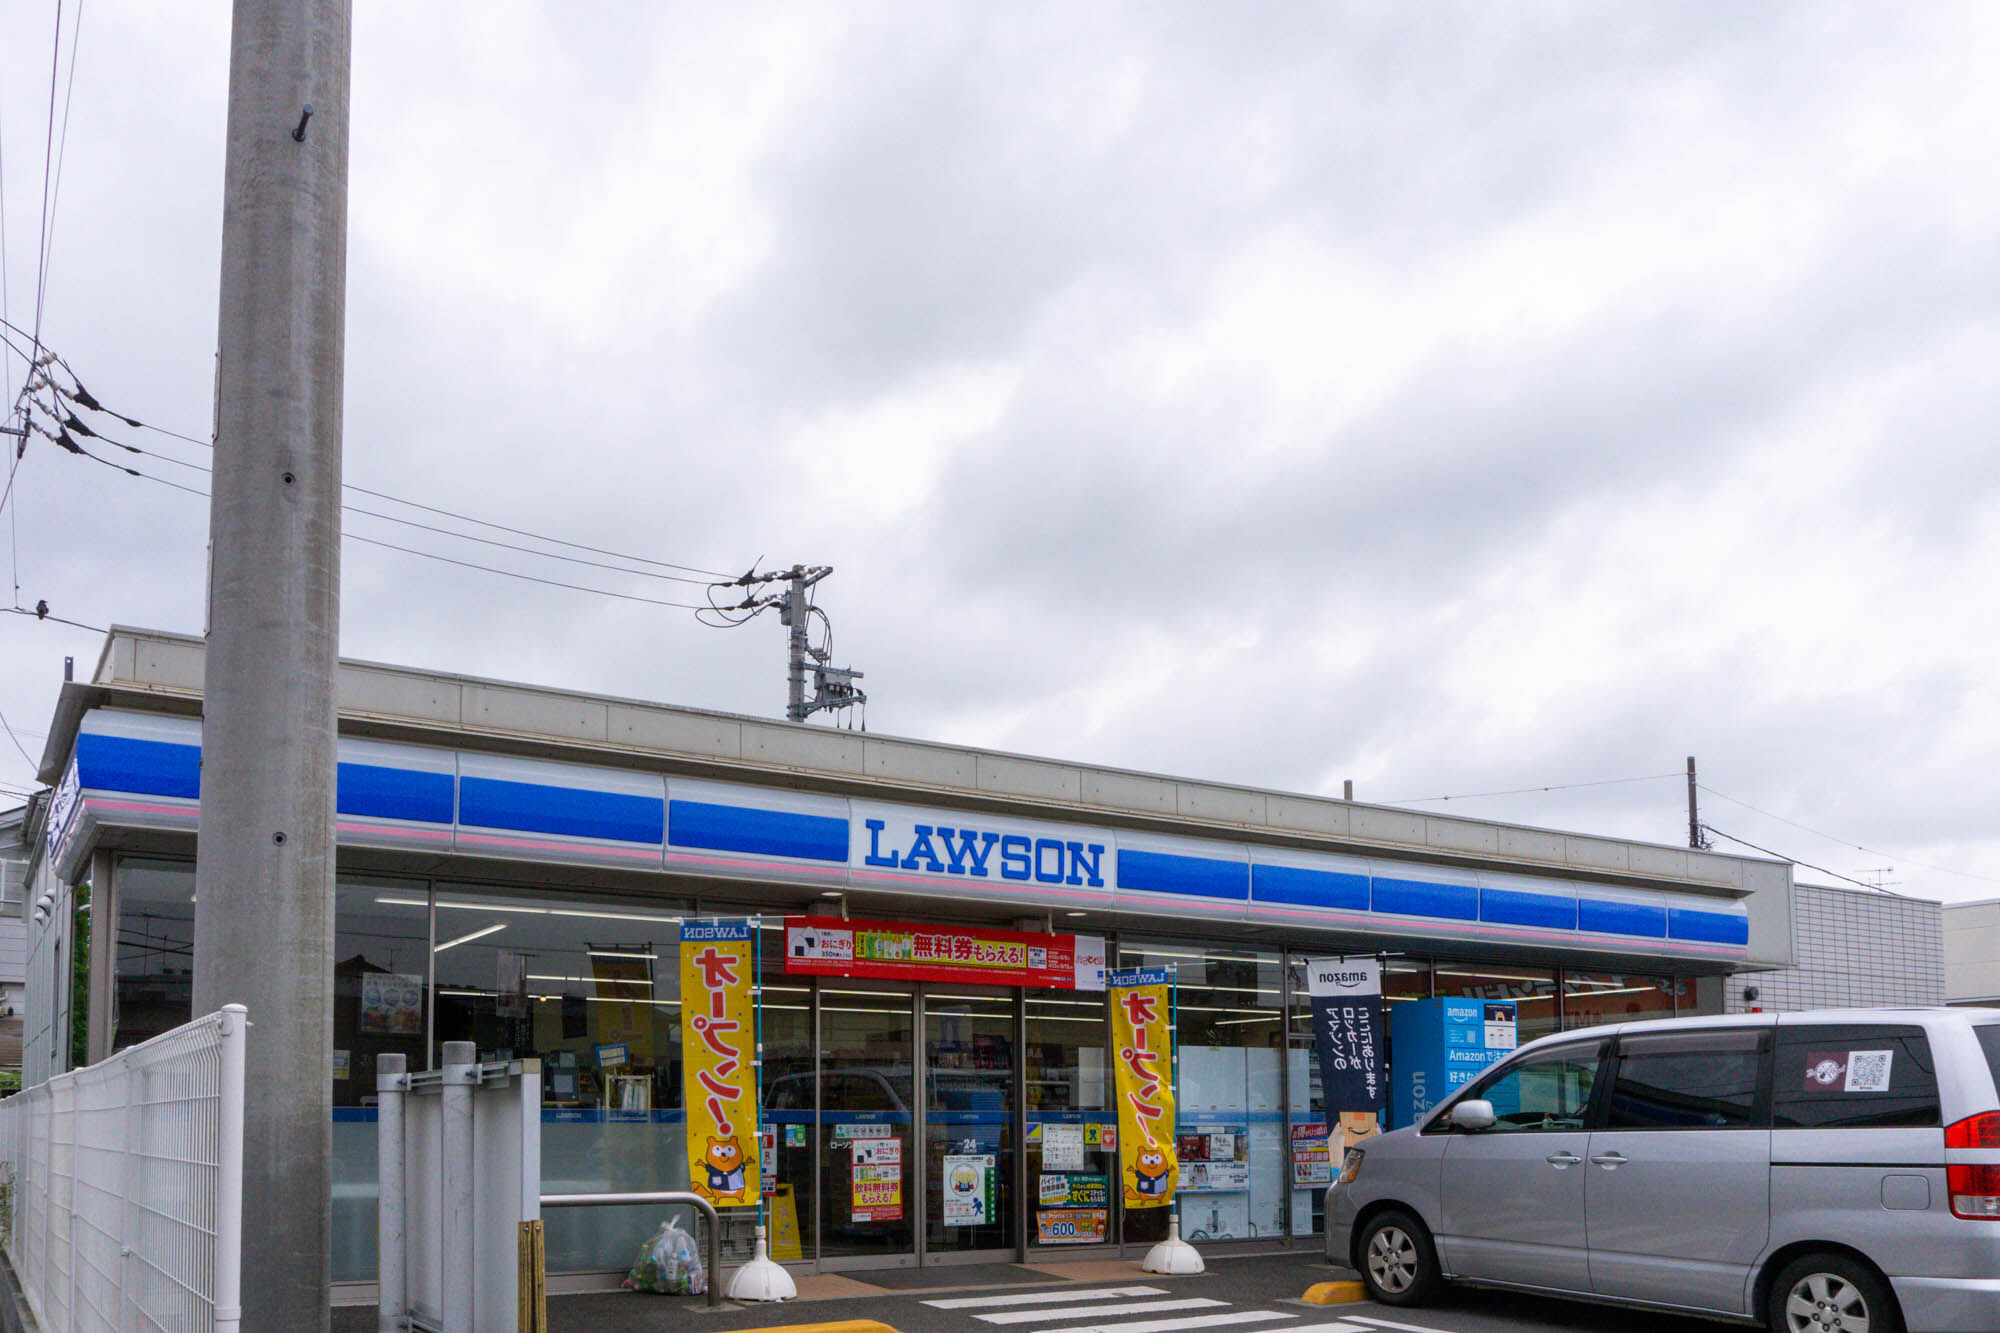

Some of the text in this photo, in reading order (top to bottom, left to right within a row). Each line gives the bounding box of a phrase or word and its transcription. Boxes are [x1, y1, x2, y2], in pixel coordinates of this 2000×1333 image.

[865, 819, 1105, 888] LAWSON
[821, 939, 851, 950] おにぎり
[1447, 1007, 1478, 1017] amazon
[1072, 1190, 1091, 1203] すぐに
[1052, 1221, 1075, 1236] 600
